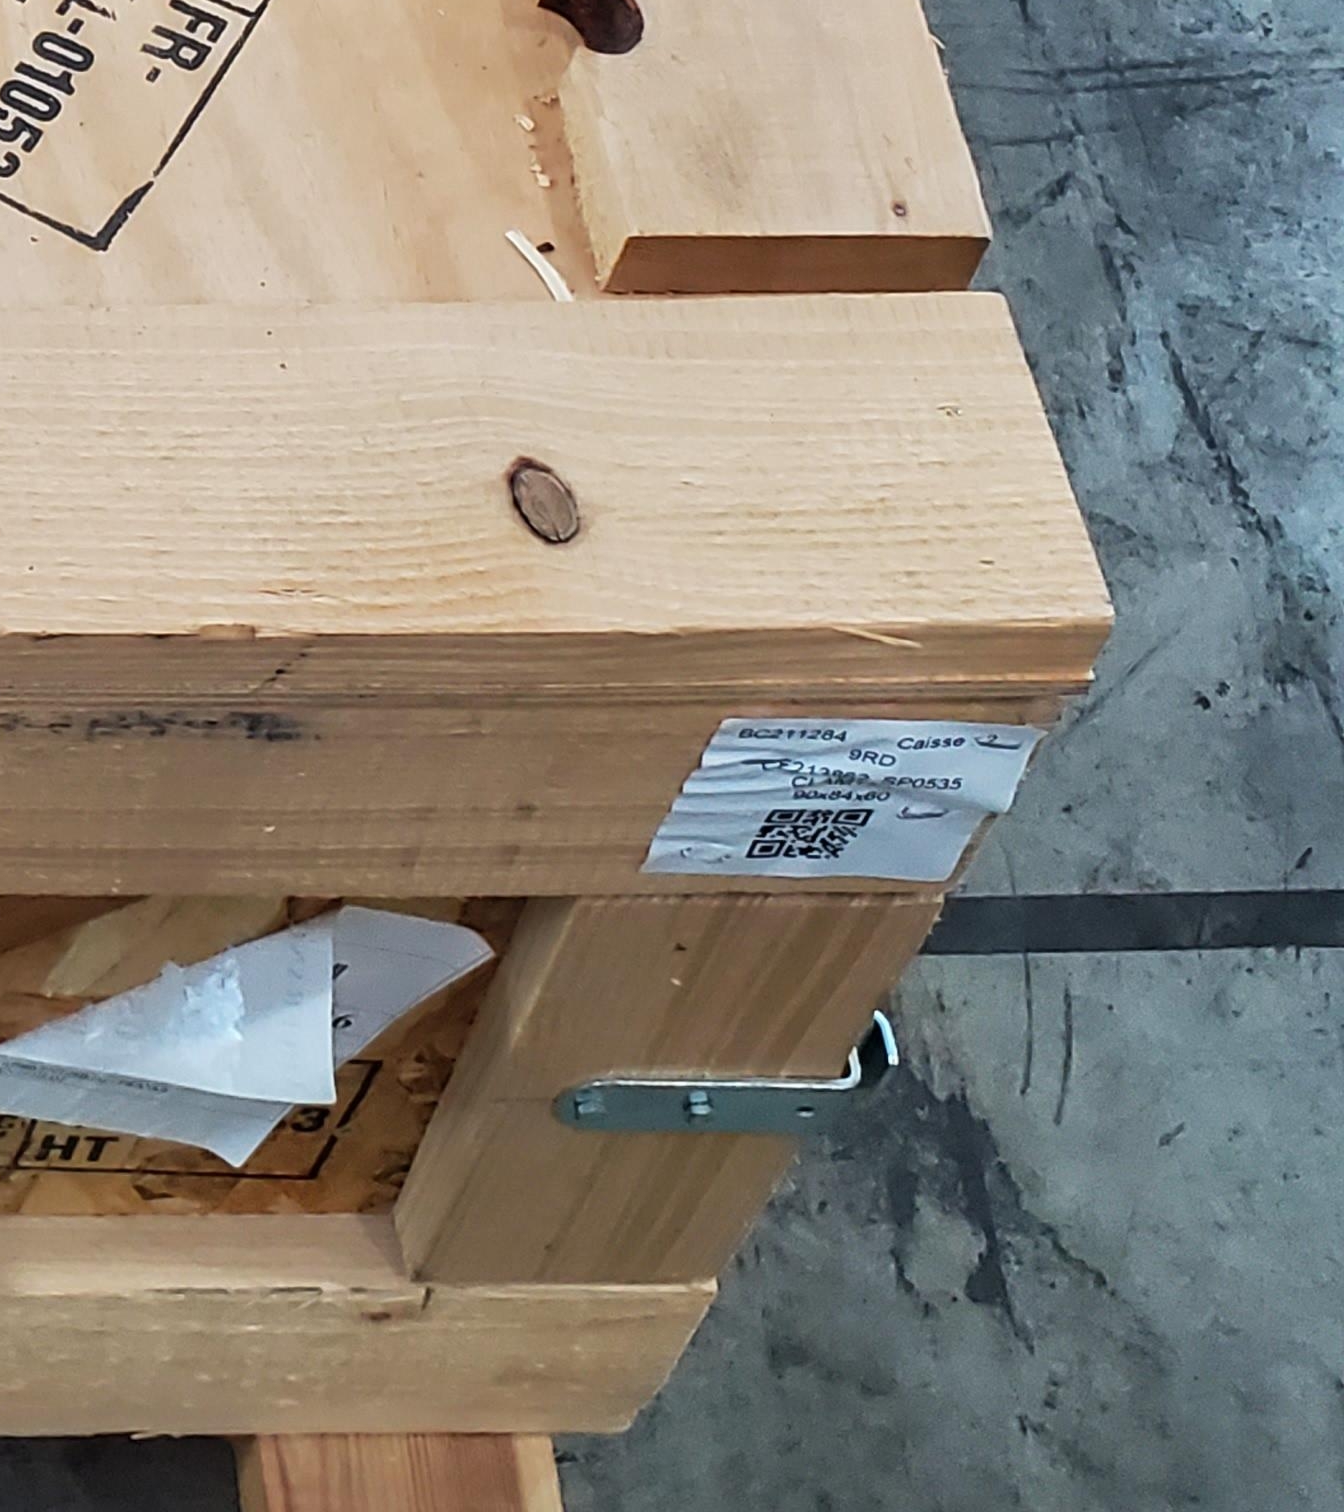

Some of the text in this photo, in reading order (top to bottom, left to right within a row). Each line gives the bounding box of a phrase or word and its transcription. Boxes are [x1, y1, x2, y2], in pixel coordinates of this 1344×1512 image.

[896, 735, 967, 751] Caisse
[847, 747, 897, 768] 9RD
[35, 1134, 120, 1163] HT
